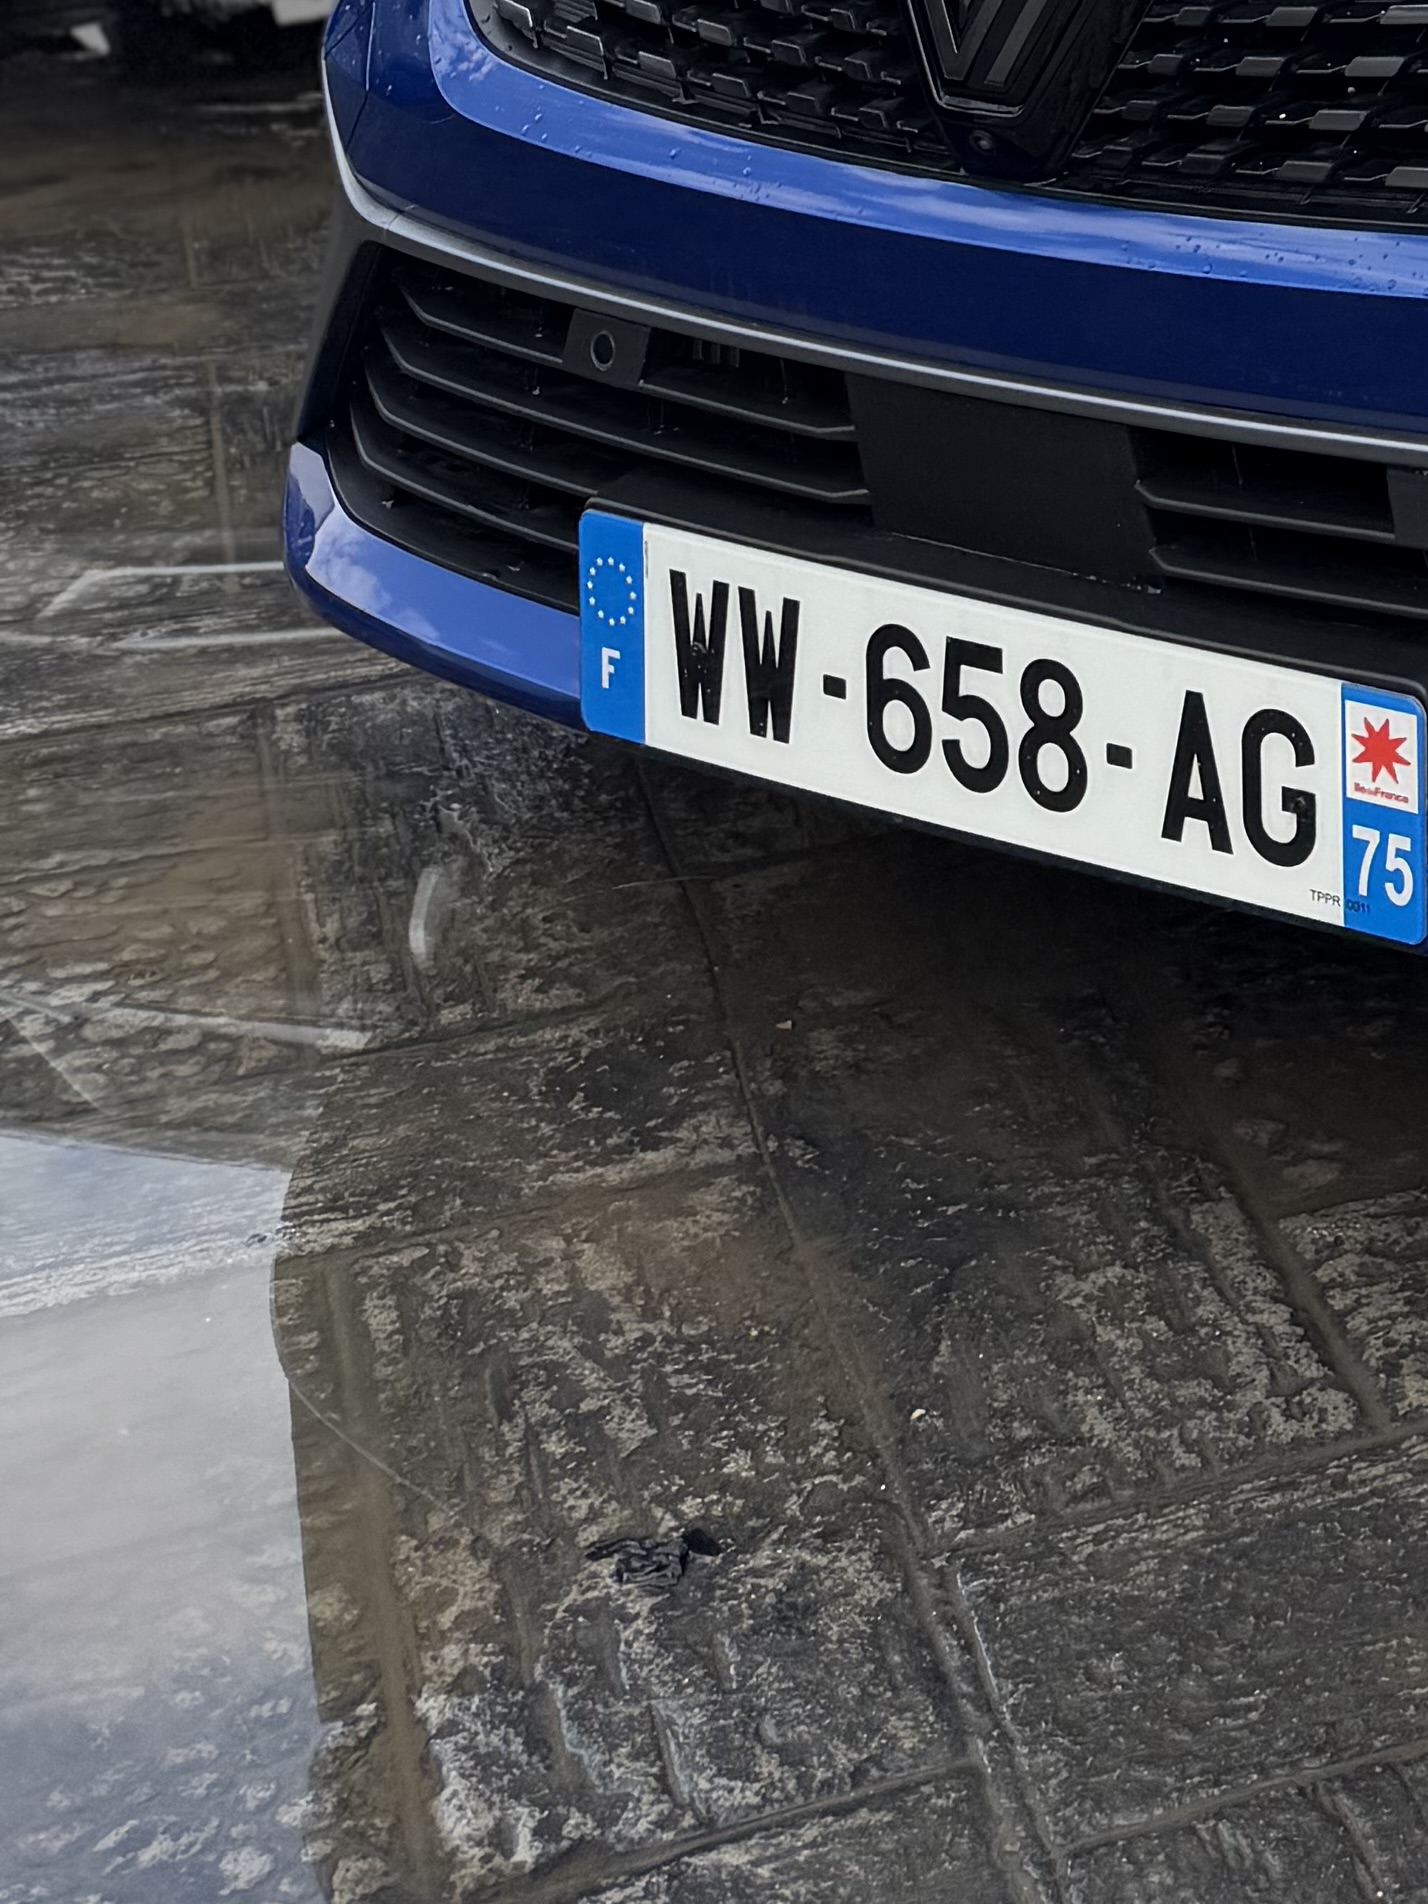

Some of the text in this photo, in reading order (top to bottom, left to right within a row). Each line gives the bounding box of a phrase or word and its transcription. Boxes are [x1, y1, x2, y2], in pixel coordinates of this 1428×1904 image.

[601, 646, 621, 689] F
[1351, 824, 1414, 907] 75
[1309, 888, 1341, 907] TPPR
